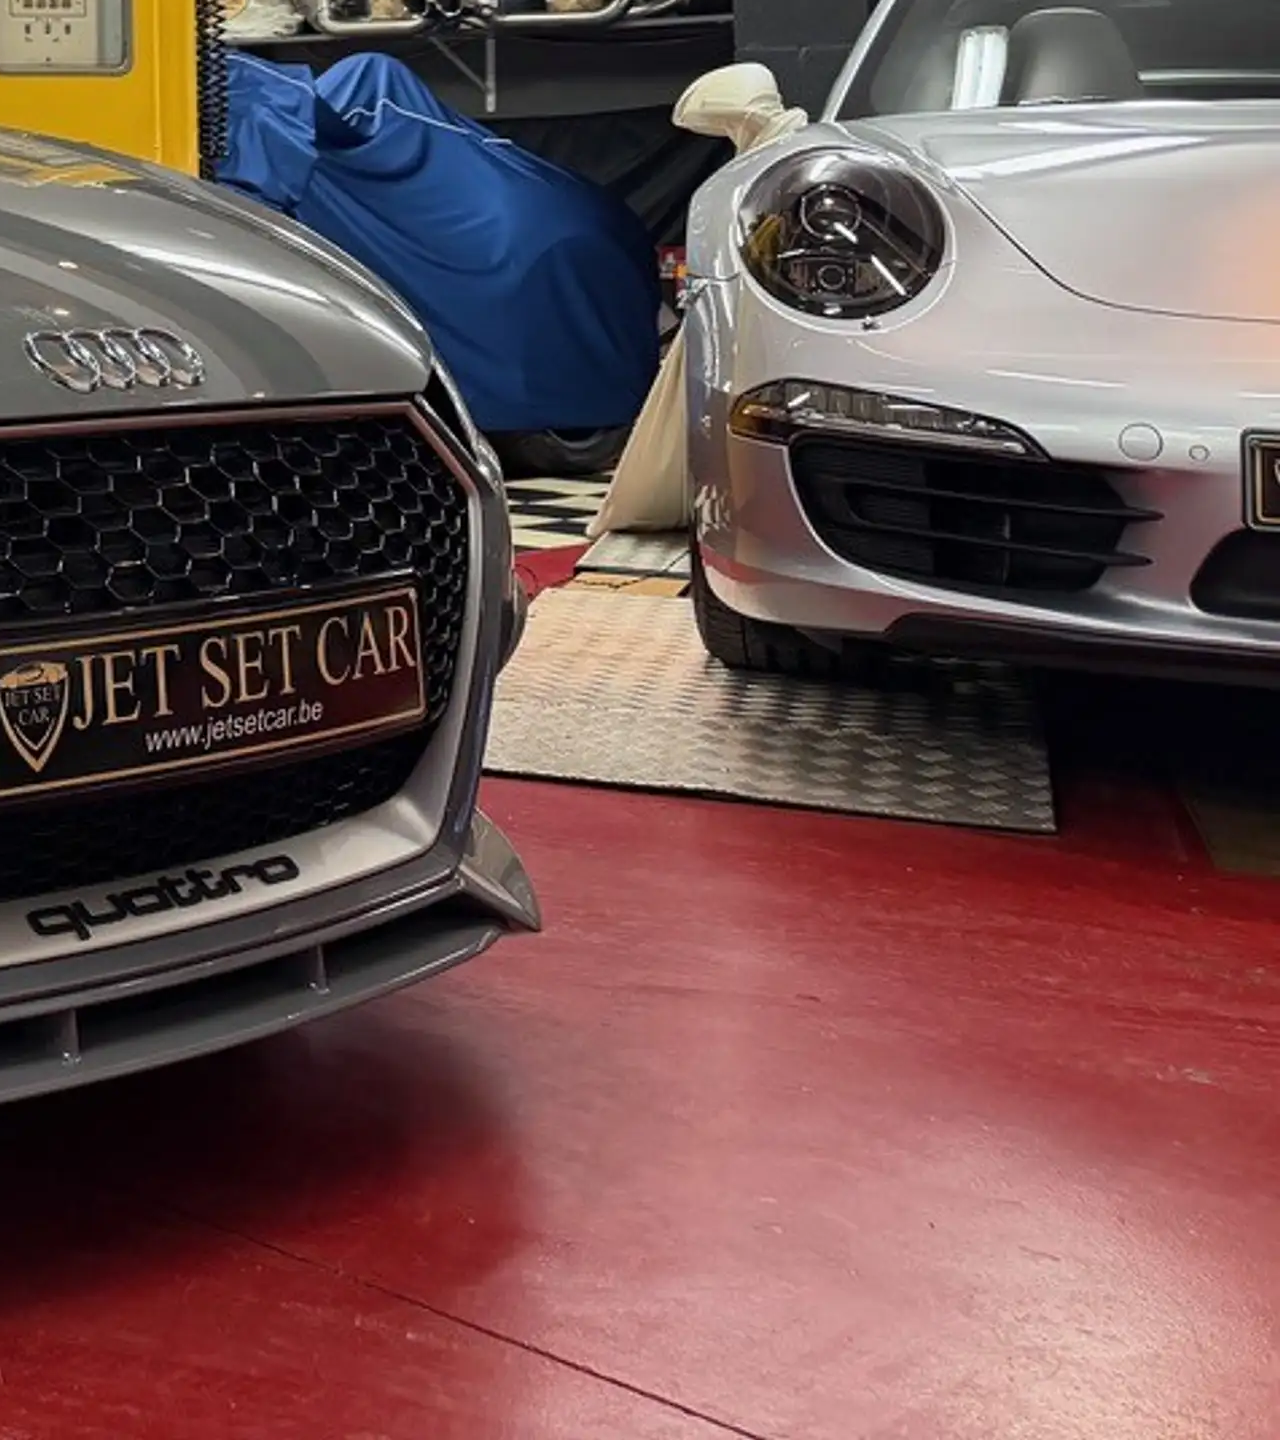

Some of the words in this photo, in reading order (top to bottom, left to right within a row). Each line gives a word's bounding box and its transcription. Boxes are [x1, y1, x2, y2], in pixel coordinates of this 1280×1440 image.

[5, 690, 31, 707] JET
[33, 683, 61, 702] SET
[73, 643, 183, 730] JET
[199, 625, 301, 710] SET
[317, 605, 417, 686] CAR
[19, 707, 51, 727] CAR
[145, 697, 325, 753] www.jetsetcar.be
[26, 854, 300, 942] quattro
